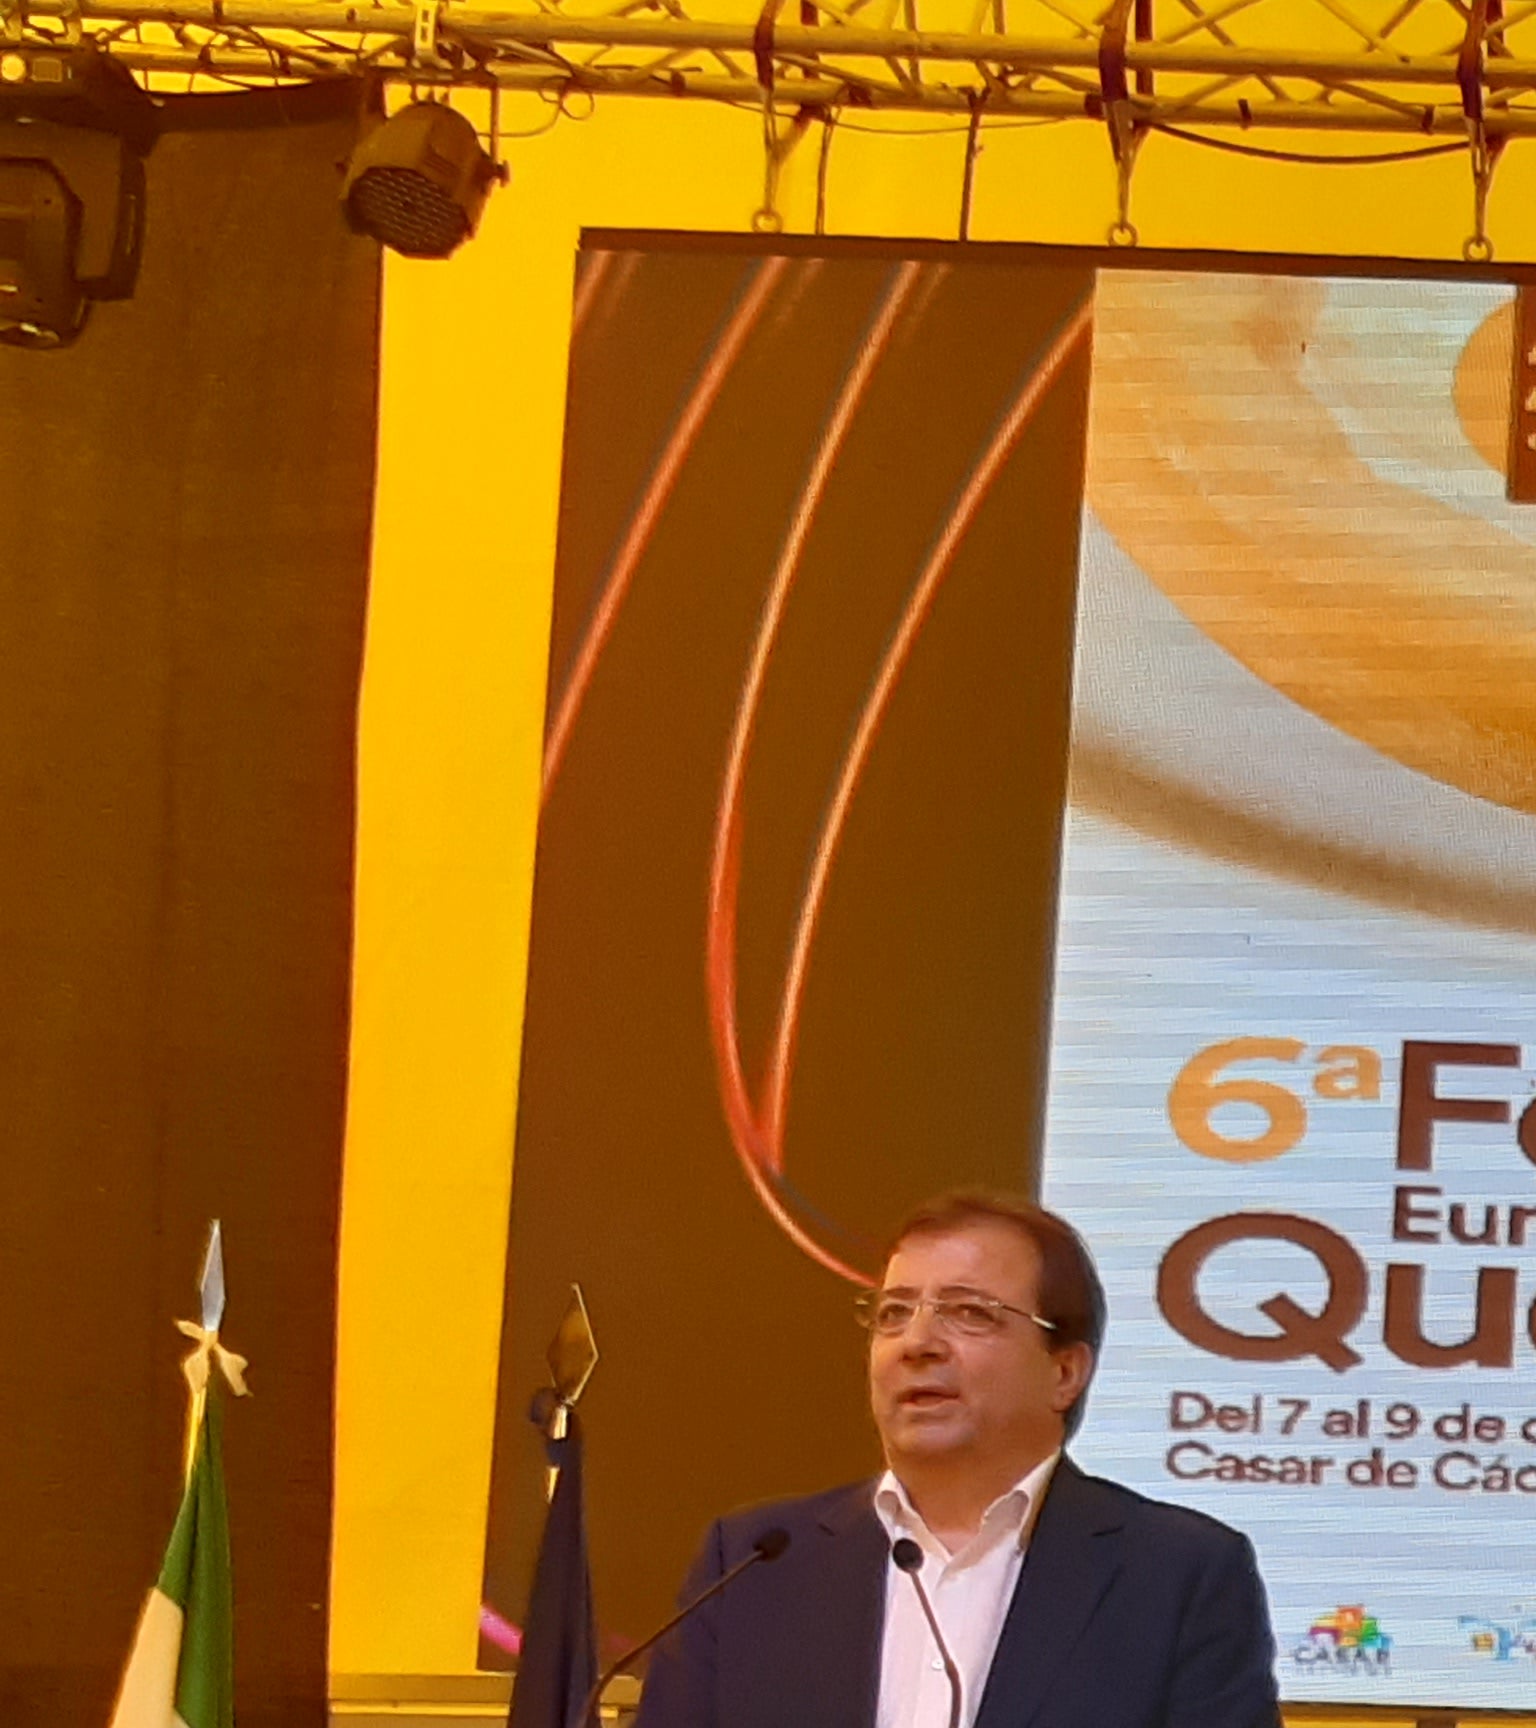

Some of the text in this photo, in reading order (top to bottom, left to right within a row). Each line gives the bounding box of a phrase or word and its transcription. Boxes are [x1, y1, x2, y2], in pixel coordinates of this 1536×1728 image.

[1167, 1036, 1382, 1164] 6ª
[1168, 1390, 1261, 1435] Del
[1279, 1398, 1309, 1435] 7
[1321, 1397, 1370, 1439] al
[1385, 1403, 1421, 1442] 9
[1433, 1402, 1507, 1444] de
[1165, 1442, 1332, 1486] Casar
[1346, 1447, 1419, 1489] de
